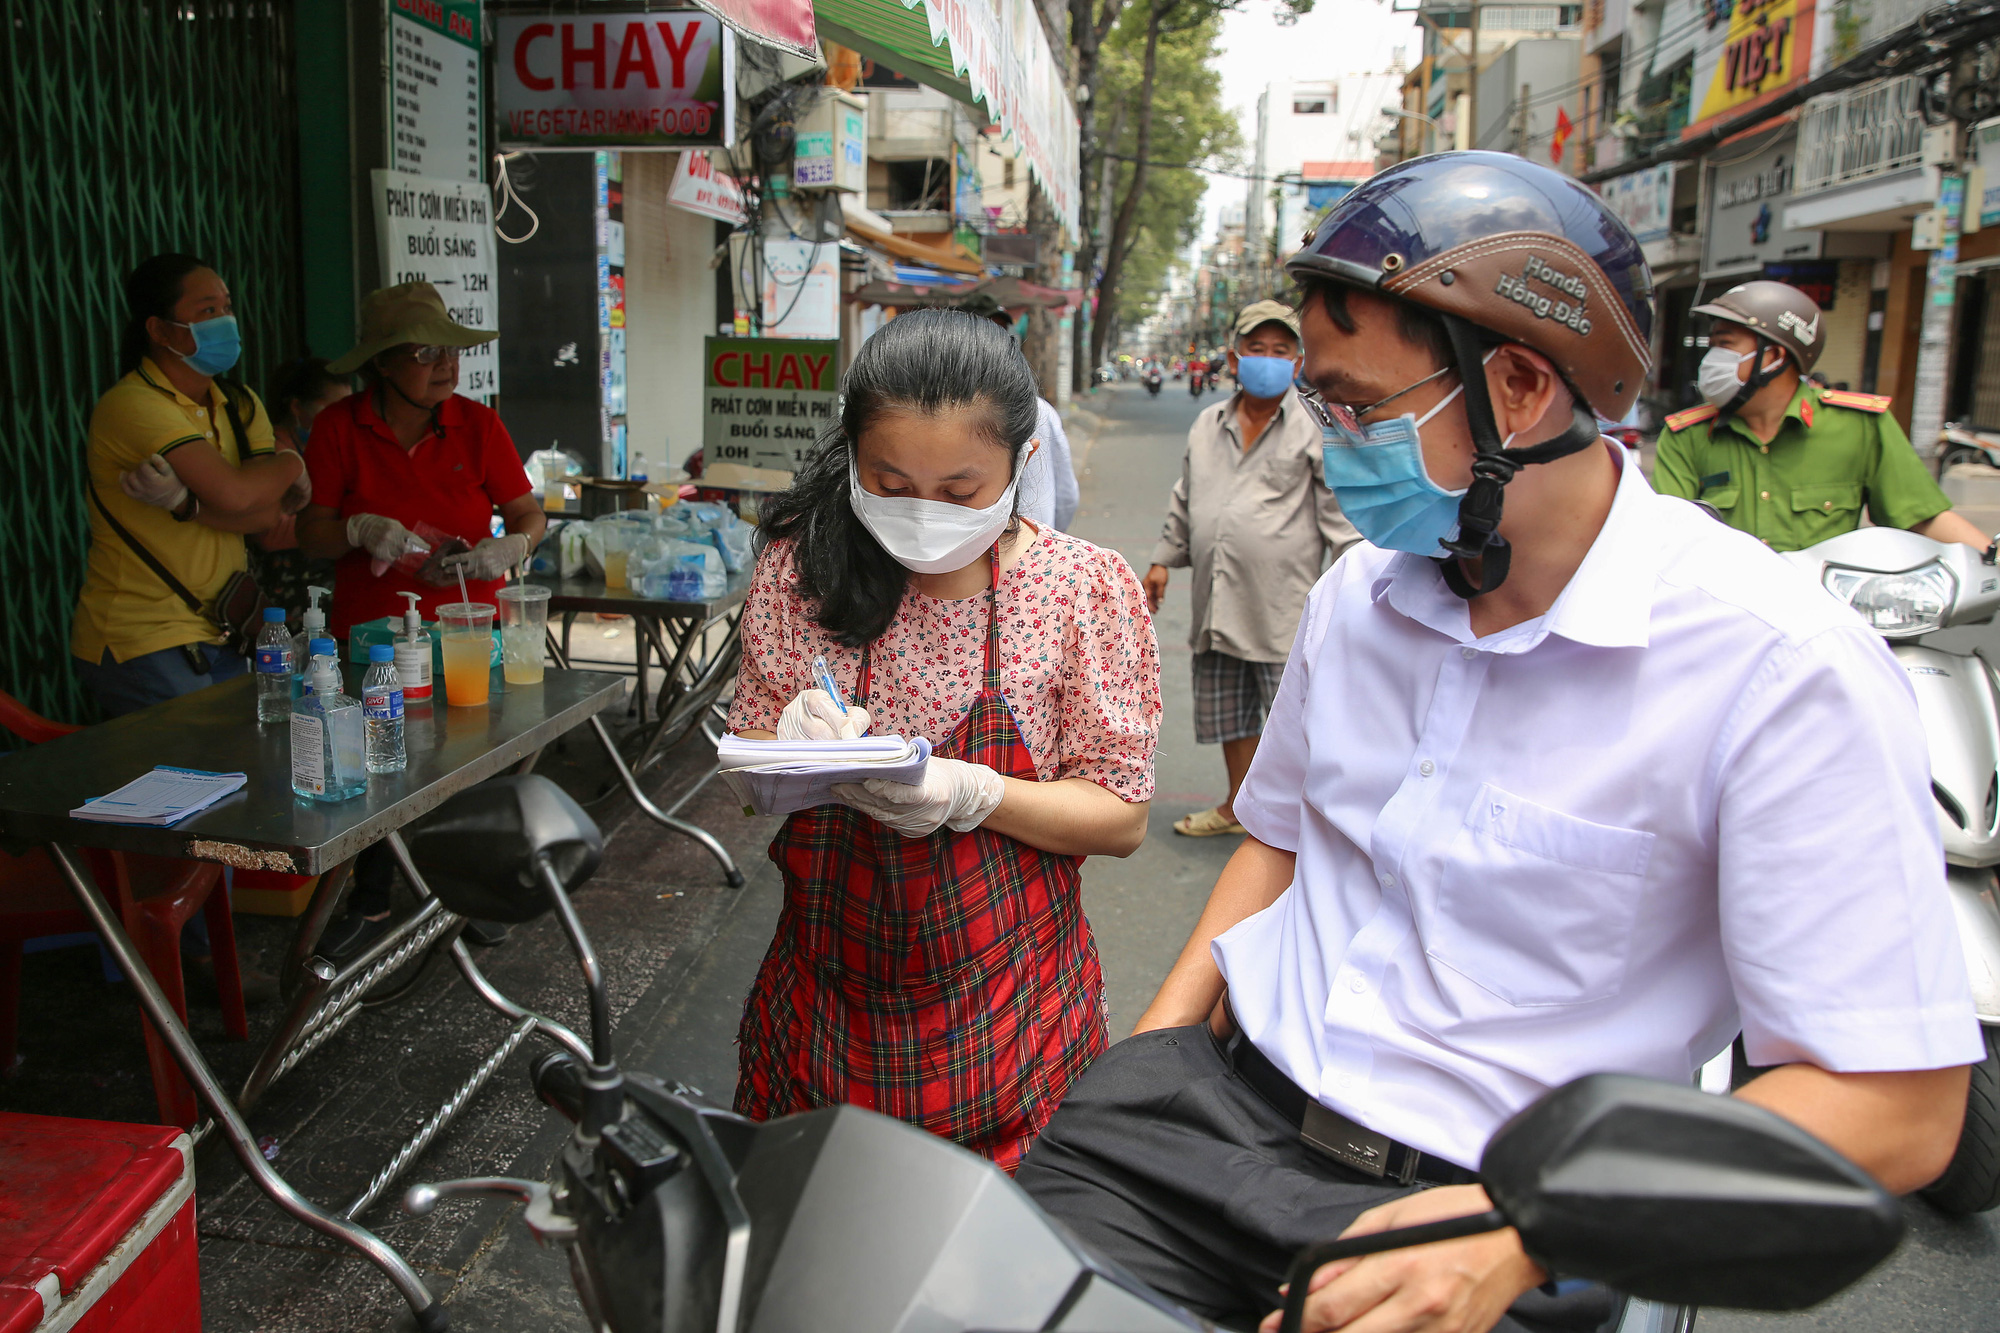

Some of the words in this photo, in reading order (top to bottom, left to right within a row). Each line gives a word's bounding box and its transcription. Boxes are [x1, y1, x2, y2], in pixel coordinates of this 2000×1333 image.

[448, 10, 473, 41] AN
[514, 21, 702, 92] CHAY
[509, 108, 645, 136] VEGETARIAN
[650, 107, 711, 136] FOOD
[386, 182, 416, 218] PHÁT
[408, 225, 440, 255] BUỔI
[444, 232, 476, 257] SÁNG
[462, 274, 488, 291] 12H
[1526, 254, 1588, 300] Honda
[1495, 273, 1552, 319] Hồng
[1553, 300, 1592, 336] Đắc
[469, 370, 494, 390] 15/4
[713, 352, 831, 391] CHAY
[711, 393, 742, 416] PHÁT
[746, 396, 773, 416] CƠM
[811, 397, 833, 419] PHÍ
[730, 419, 769, 439] BUỔI
[774, 423, 816, 440] SÁNG
[716, 446, 749, 459] 10H
